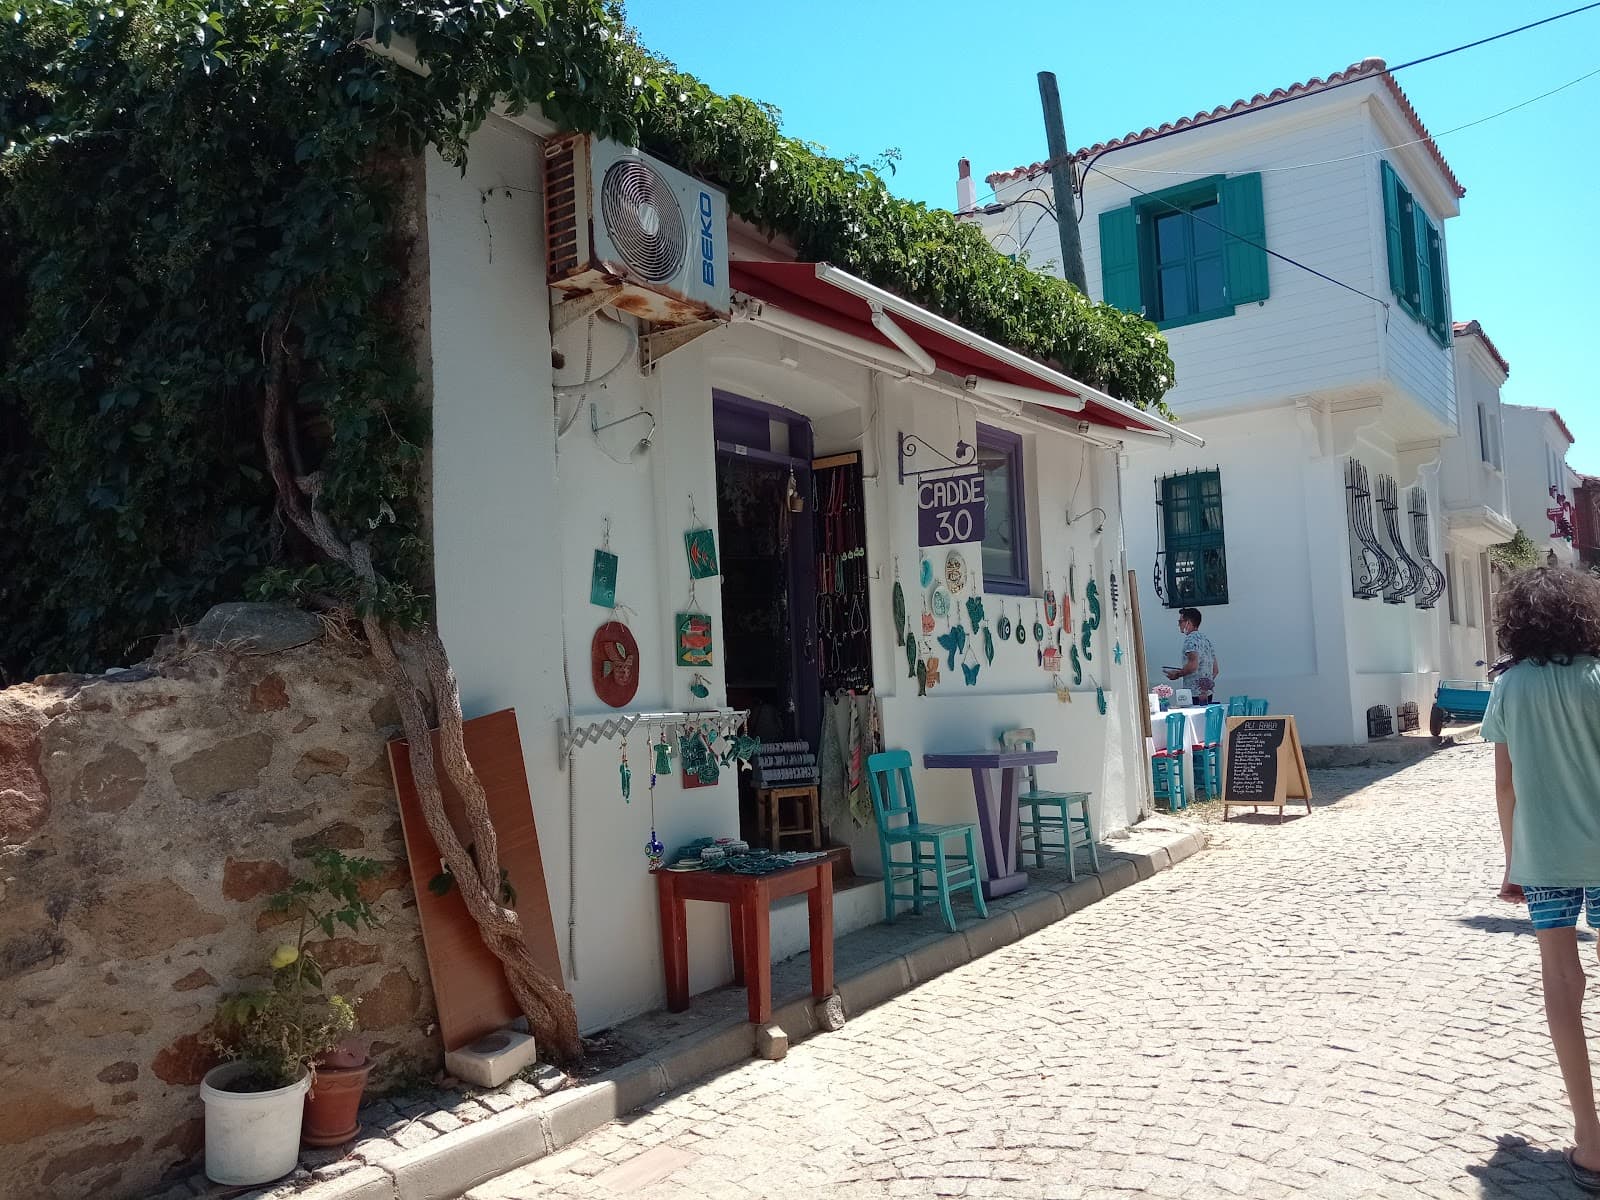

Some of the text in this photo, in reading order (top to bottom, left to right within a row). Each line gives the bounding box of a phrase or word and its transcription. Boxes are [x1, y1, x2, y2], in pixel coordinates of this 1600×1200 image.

[699, 191, 715, 287] BEKO
[918, 477, 984, 509] CADDE
[936, 509, 972, 543] 30
